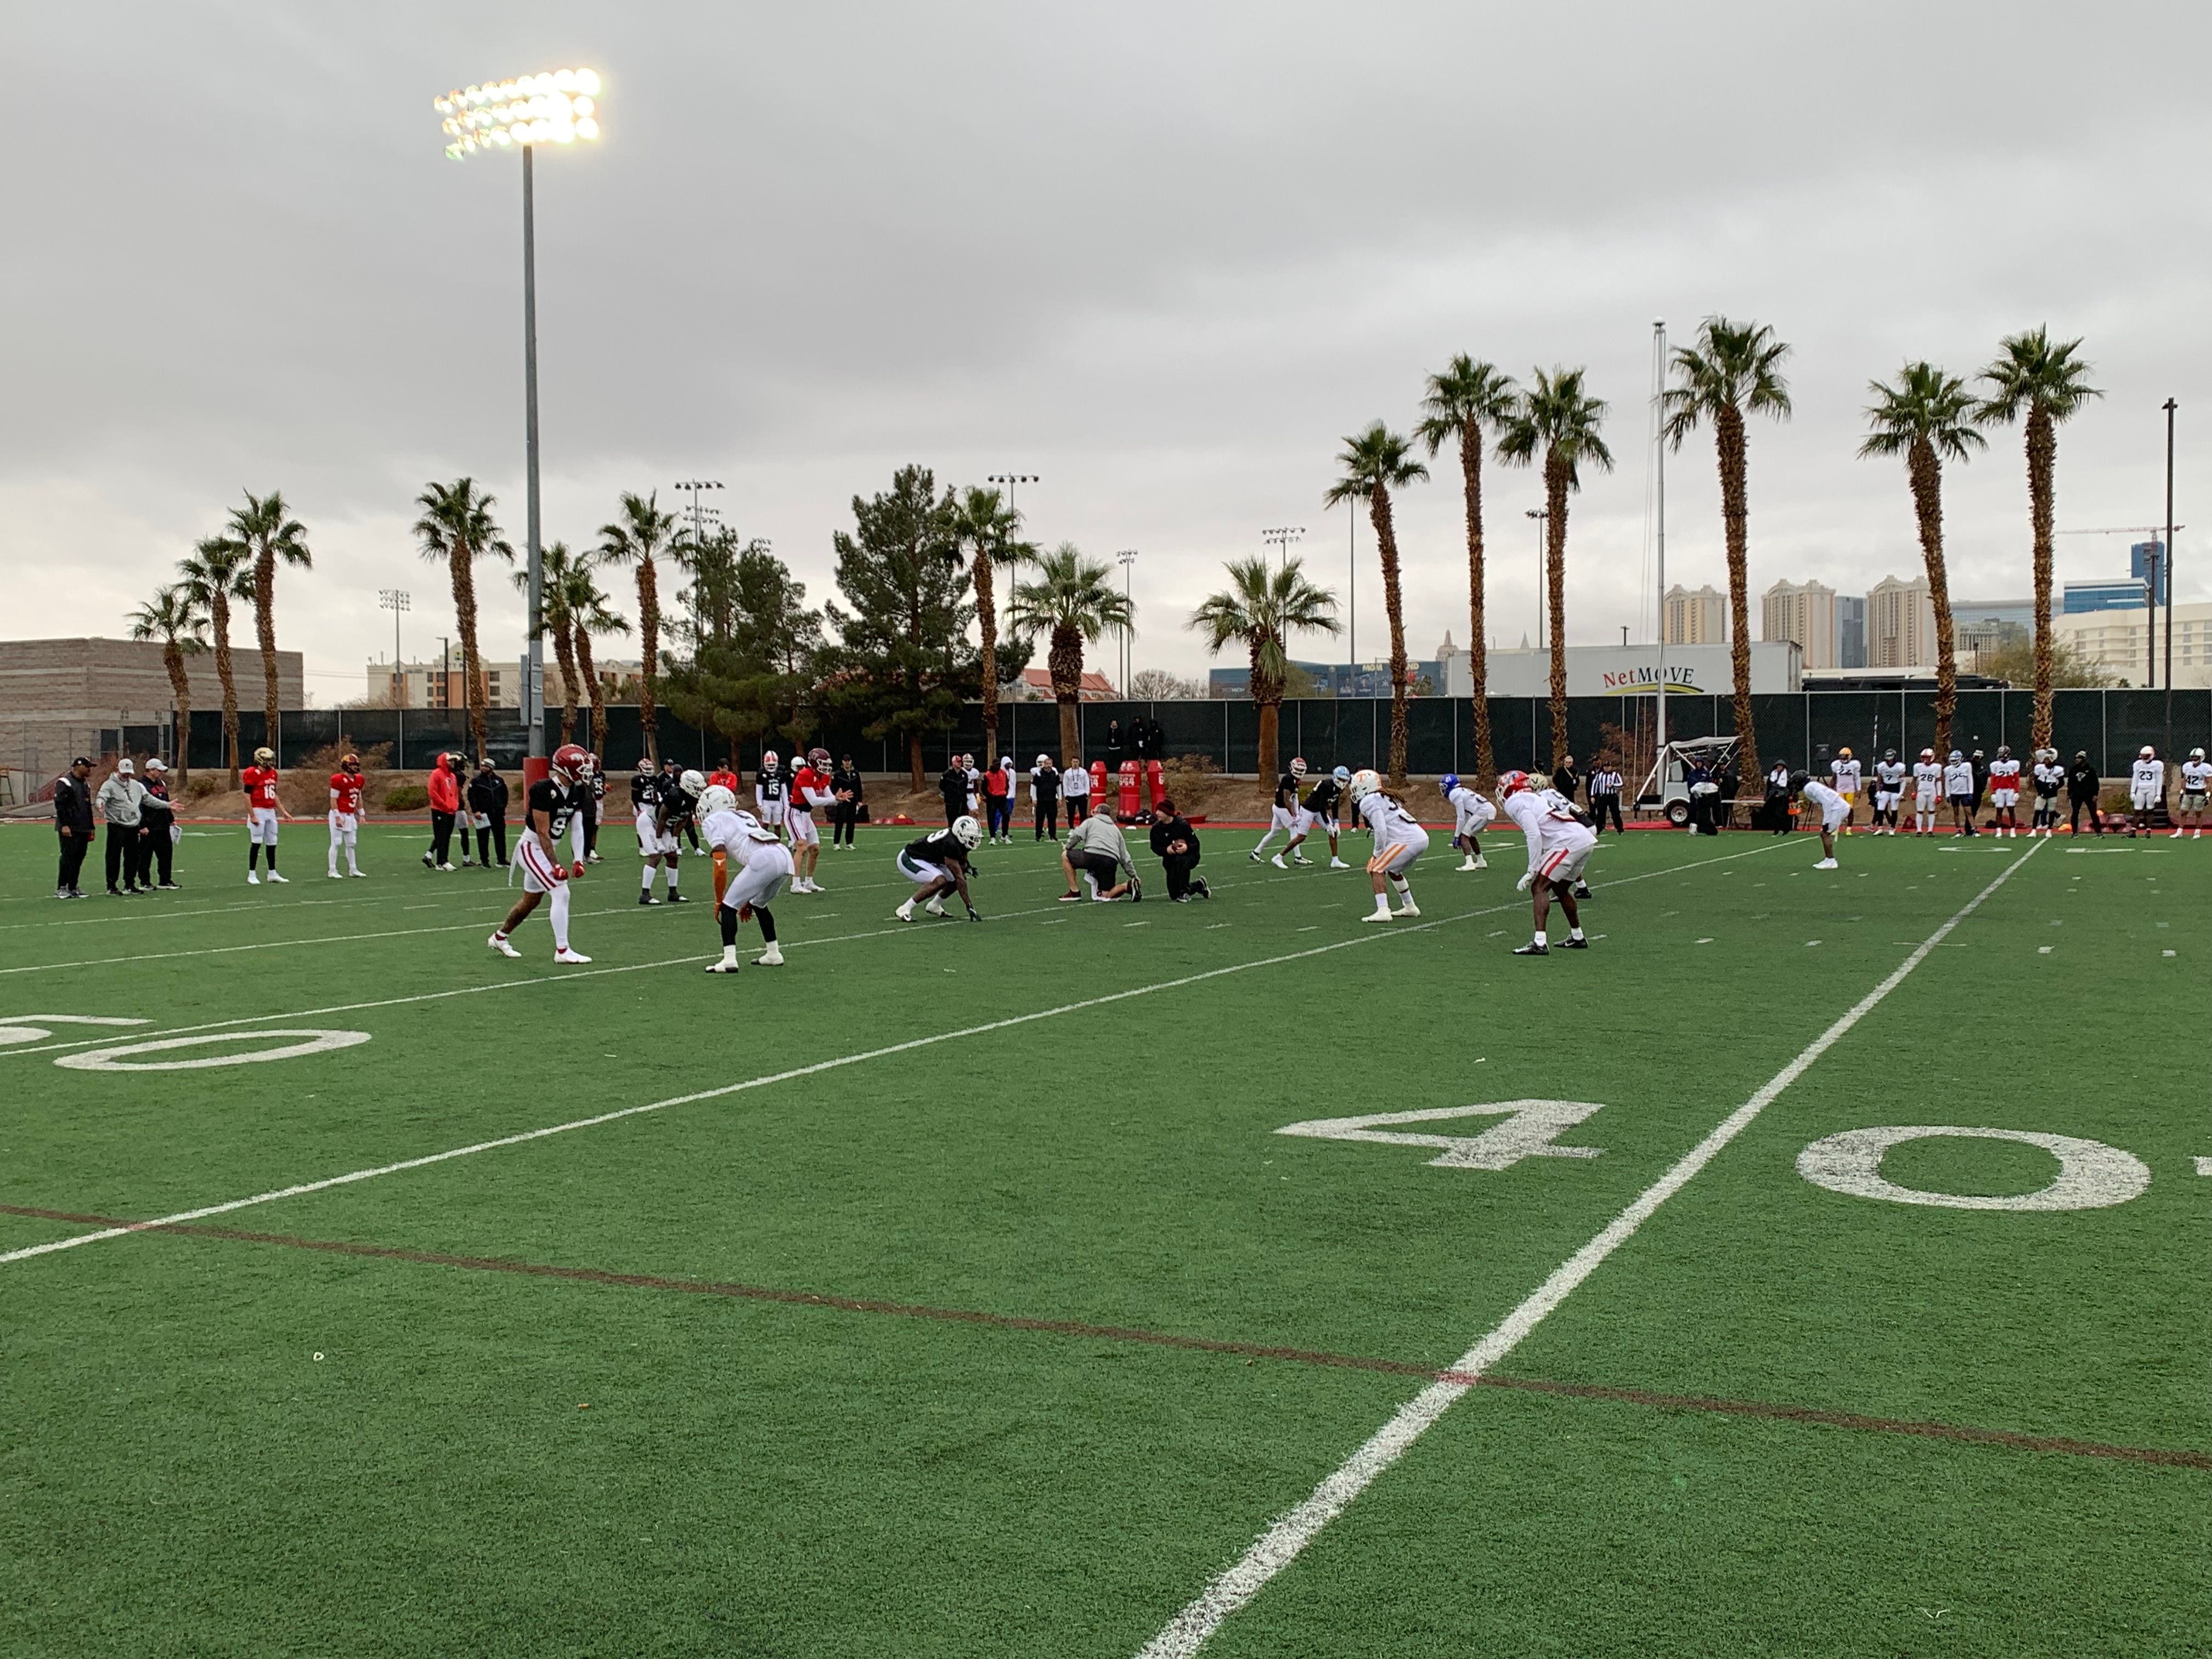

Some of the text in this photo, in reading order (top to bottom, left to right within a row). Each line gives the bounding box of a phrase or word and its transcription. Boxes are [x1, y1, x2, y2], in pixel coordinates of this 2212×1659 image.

[1362, 663, 1383, 672] MGM
[1920, 774, 1934, 782] 28
[2140, 771, 2153, 780] 23
[2186, 775, 2199, 785] 42
[263, 785, 275, 799] 16
[769, 783, 780, 795] 15
[348, 793, 358, 808] 3
